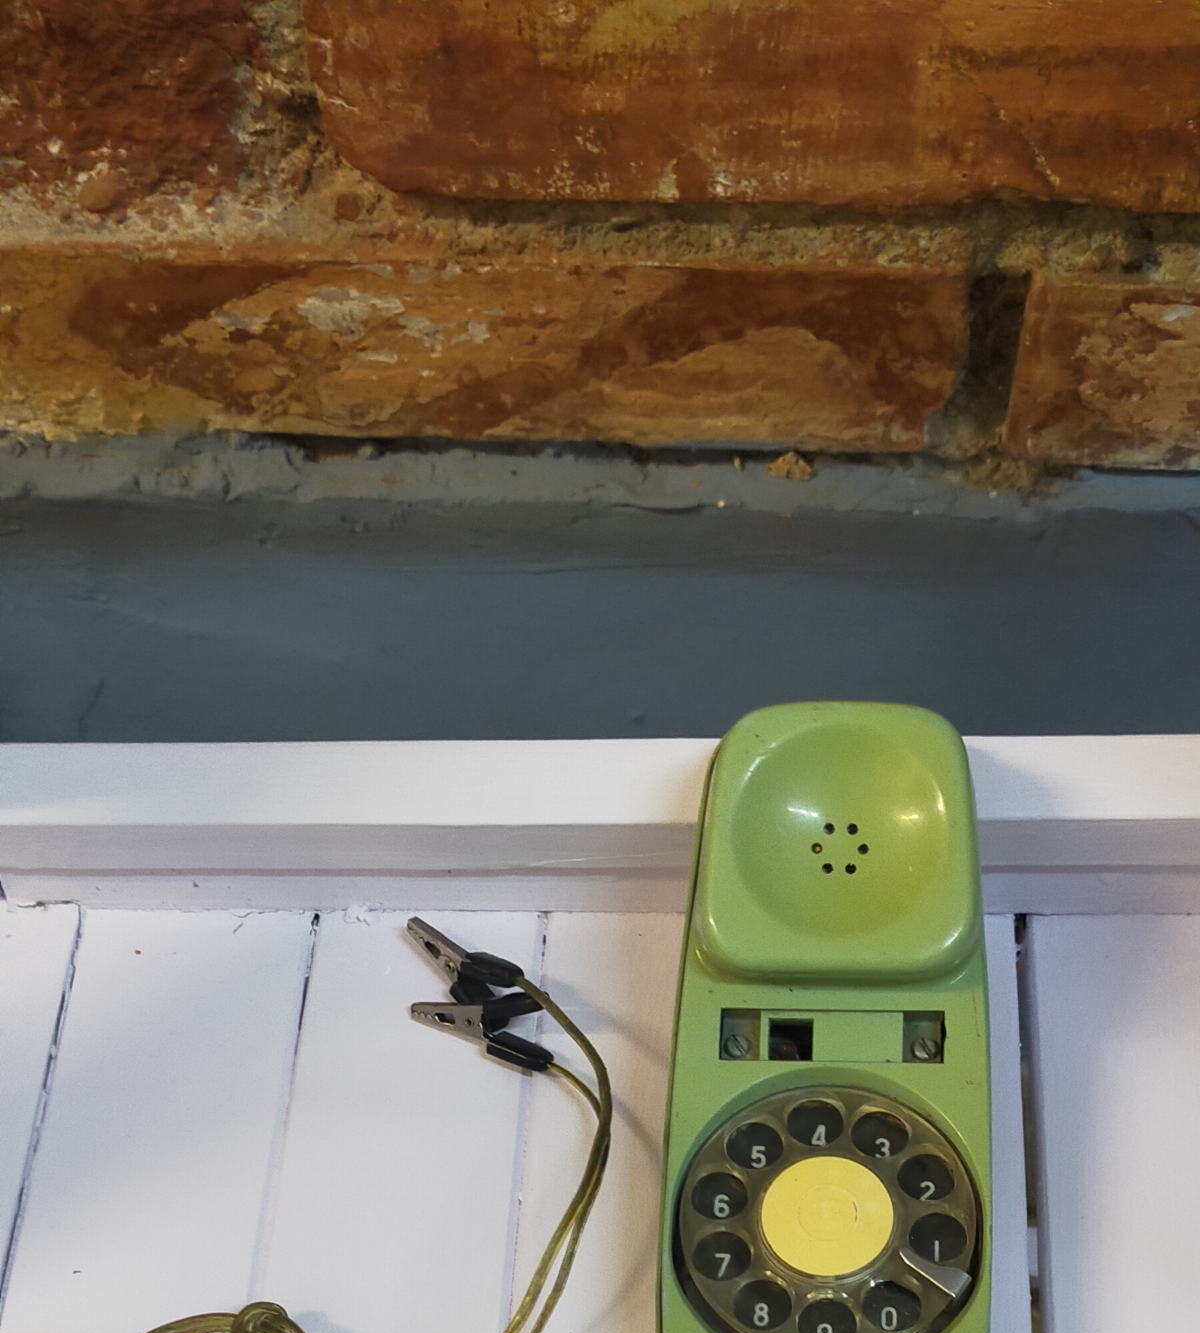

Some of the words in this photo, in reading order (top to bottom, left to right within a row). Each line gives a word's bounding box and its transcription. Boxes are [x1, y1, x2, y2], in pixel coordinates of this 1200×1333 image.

[811, 1124, 827, 1146] 4
[750, 1146, 766, 1168] 5
[875, 1138, 890, 1159] 3
[920, 1181, 936, 1202] 2
[713, 1194, 730, 1218] 6
[934, 1240, 940, 1262] 1
[714, 1253, 731, 1278] 7
[752, 1302, 769, 1326] 8
[881, 1307, 897, 1330] 0
